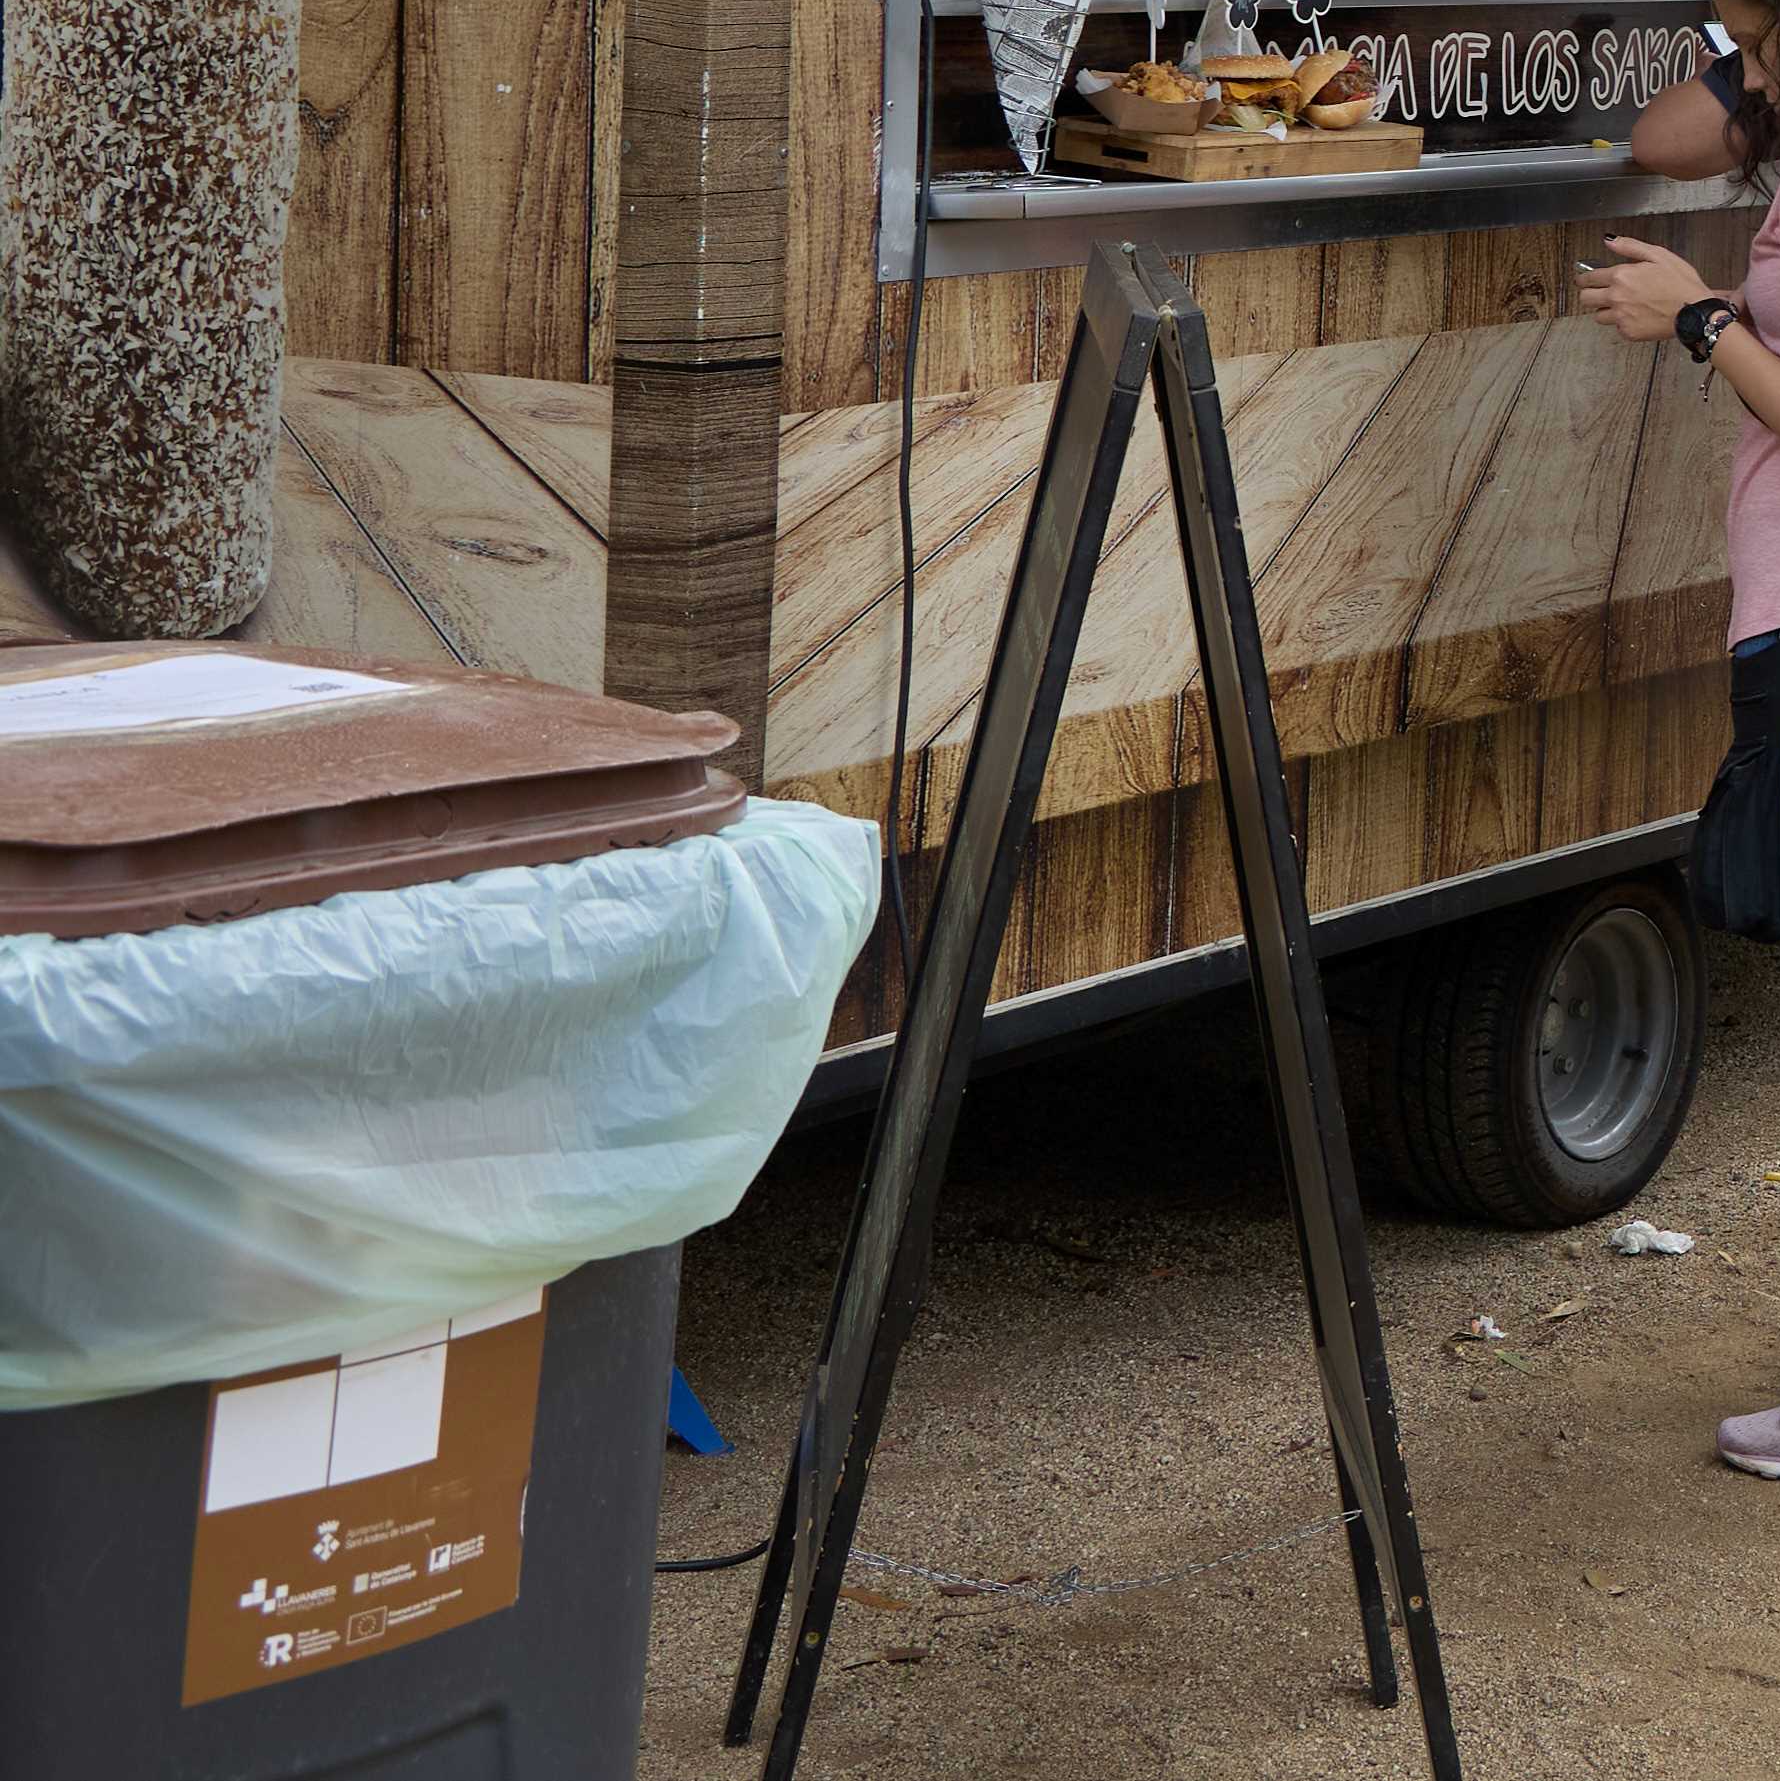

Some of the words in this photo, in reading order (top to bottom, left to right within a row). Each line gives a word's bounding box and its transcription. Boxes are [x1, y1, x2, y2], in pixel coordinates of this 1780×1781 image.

[1430, 31, 1492, 122] DE
[1501, 28, 1581, 115] LOS
[1590, 26, 1702, 112] SABO
[276, 1584, 337, 1608] LLAVANERES
